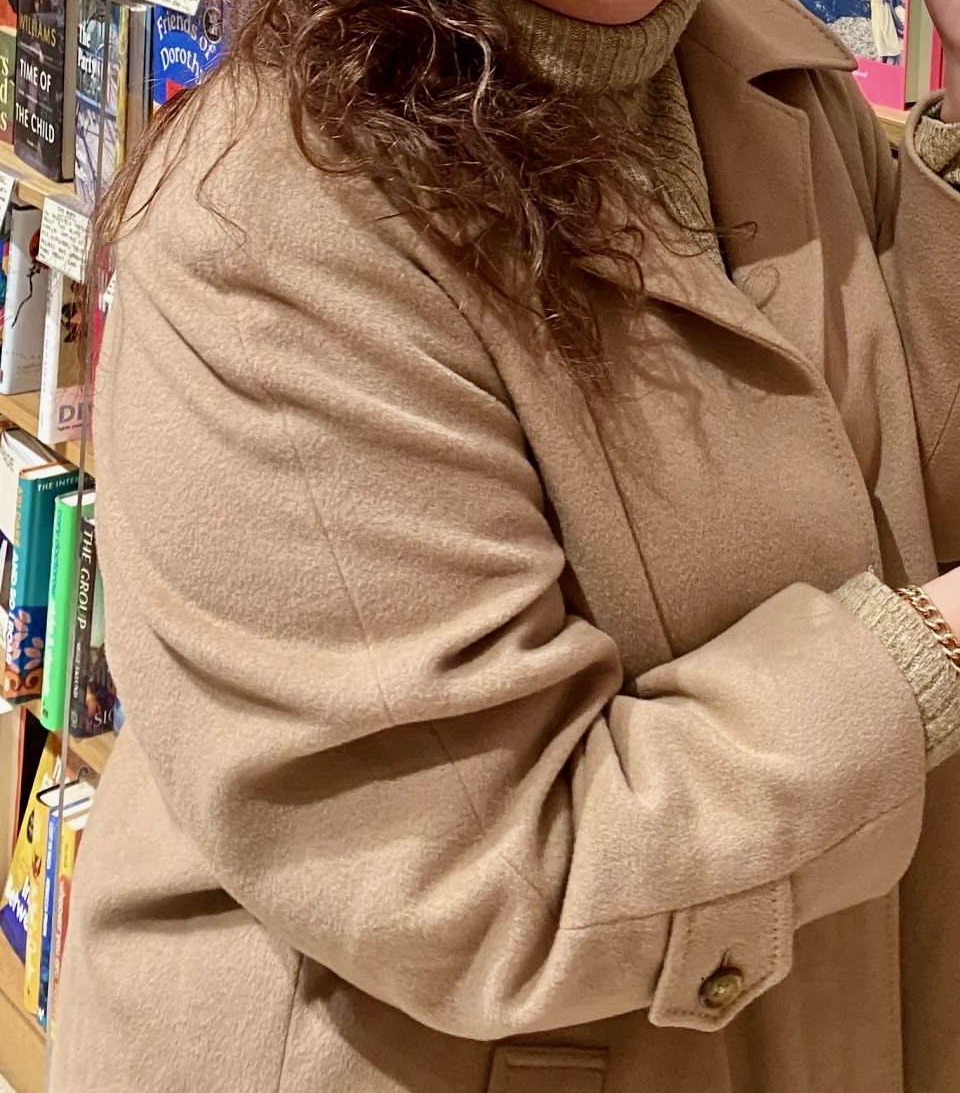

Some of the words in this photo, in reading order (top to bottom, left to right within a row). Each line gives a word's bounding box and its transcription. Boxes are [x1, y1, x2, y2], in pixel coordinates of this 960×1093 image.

[20, 12, 56, 47] WILLIAMS
[156, 10, 198, 41] Friends
[199, 34, 217, 61] of
[20, 58, 38, 87] TIME
[39, 70, 51, 93] OF
[16, 102, 29, 129] THE
[30, 113, 55, 144] CHILD
[83, 529, 94, 564] THE
[78, 568, 91, 630] GROUP
